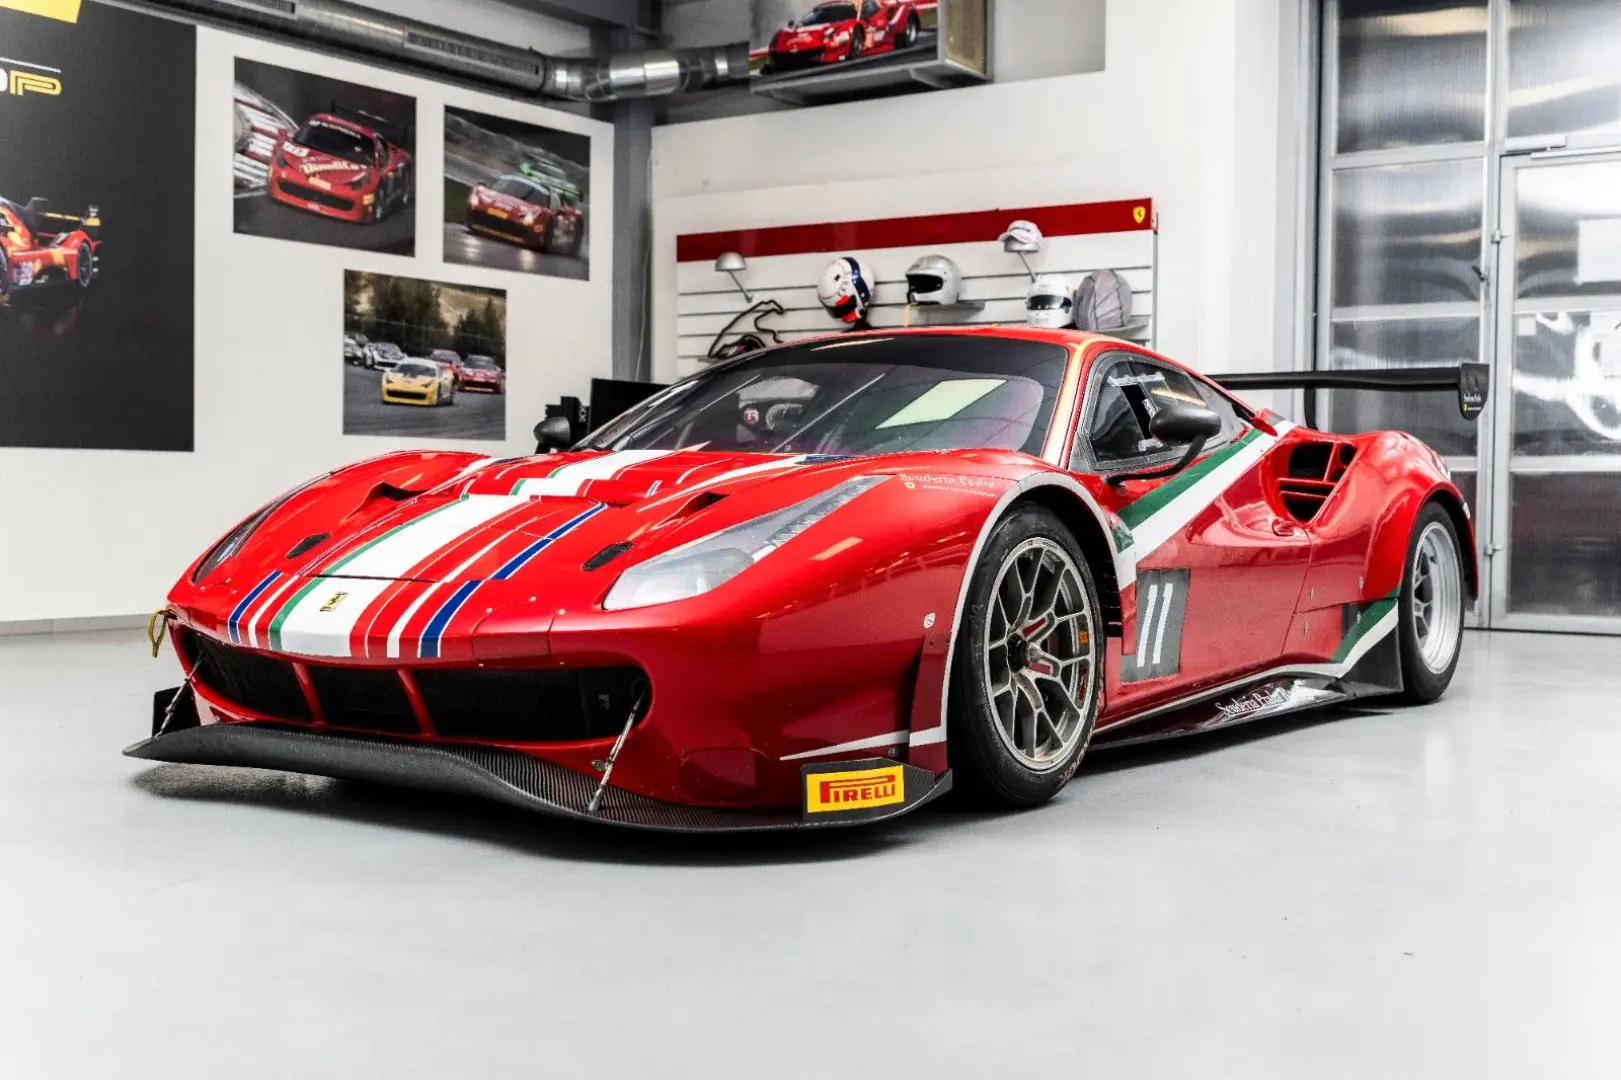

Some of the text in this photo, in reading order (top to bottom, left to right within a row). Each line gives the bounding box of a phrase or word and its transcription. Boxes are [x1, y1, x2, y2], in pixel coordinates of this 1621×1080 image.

[1136, 583, 1173, 668] 11
[1215, 697, 1259, 717] Scuderia
[819, 774, 897, 804] PIRELLI
